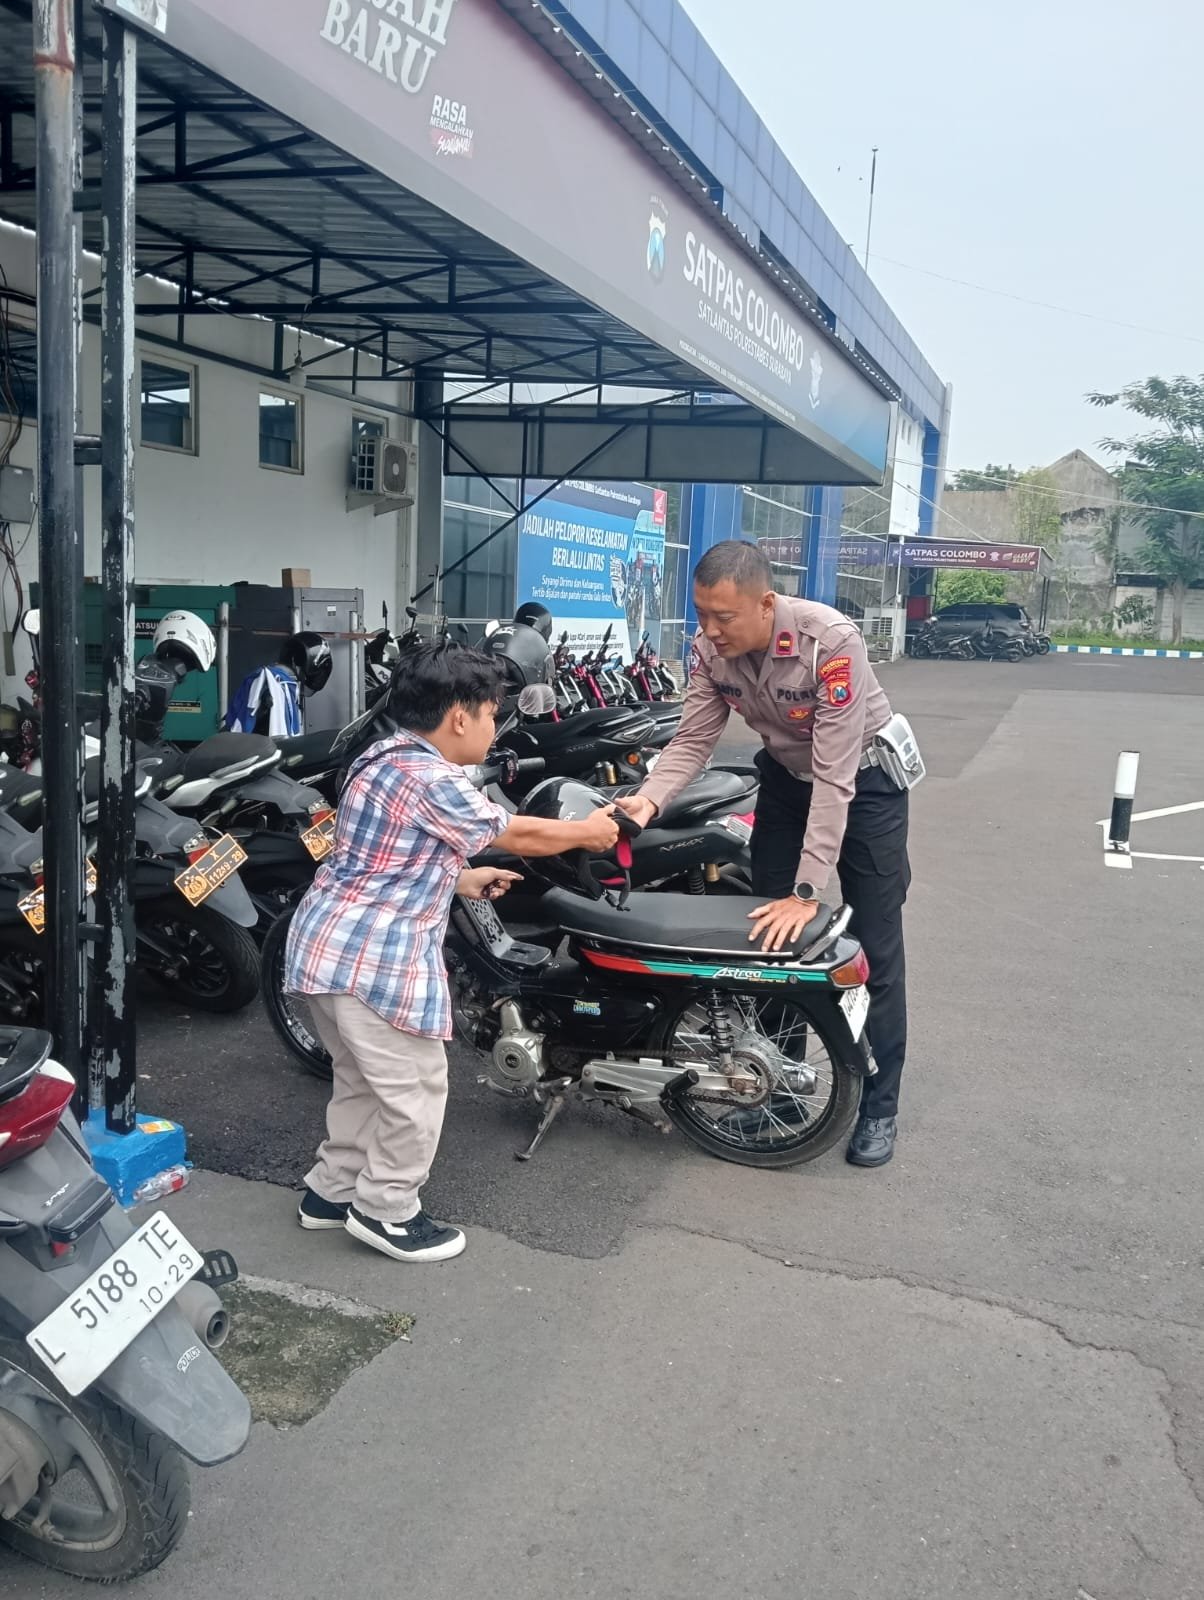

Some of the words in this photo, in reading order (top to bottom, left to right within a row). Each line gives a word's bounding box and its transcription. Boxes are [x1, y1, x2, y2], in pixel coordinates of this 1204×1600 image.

[319, 0, 437, 94] BARU
[431, 94, 467, 126] RASA
[429, 116, 474, 139] MENGALAHKAN
[683, 231, 744, 321] SATPAS
[746, 289, 804, 371] COLOMBO
[698, 300, 733, 341] SATLANTAS
[733, 327, 769, 369] POLRESTABES
[522, 514, 555, 538] JADILAH
[554, 521, 586, 543] PELOPOR
[585, 527, 629, 551] KESELAMATAN
[552, 547, 584, 570] BERLALU
[583, 552, 605, 572] LINTAS
[904, 549, 939, 557] SATPAS
[940, 550, 987, 559] COLOMBO
[541, 574, 560, 588] Sayangi
[209, 850, 220, 861] X
[34, 1337, 67, 1365] L
[70, 1258, 138, 1330] 5188
[138, 1219, 178, 1260] TE
